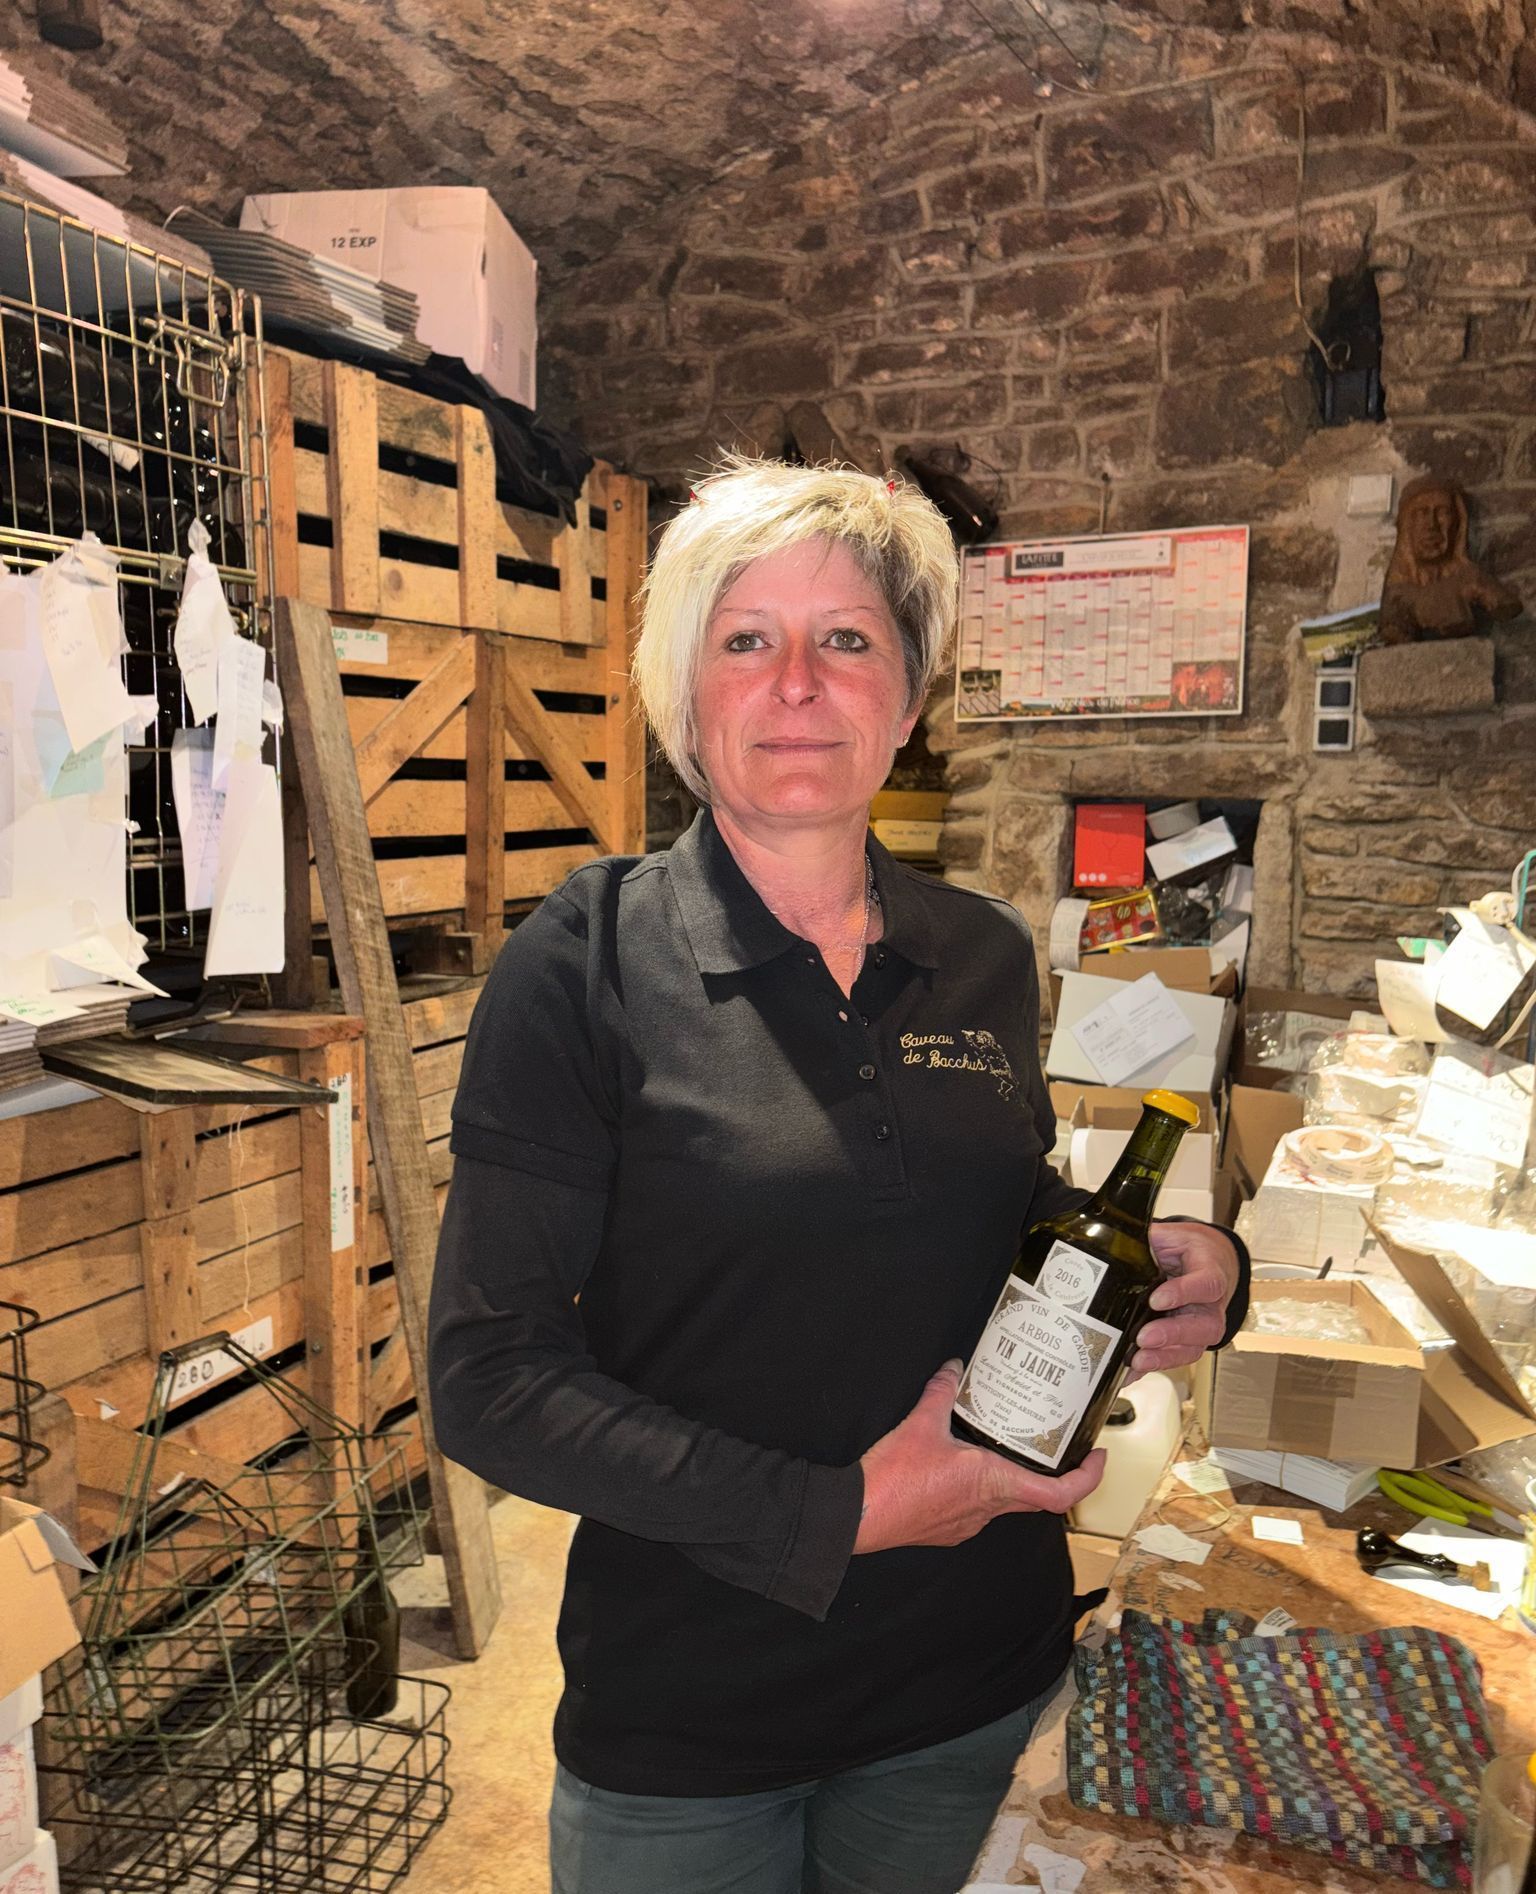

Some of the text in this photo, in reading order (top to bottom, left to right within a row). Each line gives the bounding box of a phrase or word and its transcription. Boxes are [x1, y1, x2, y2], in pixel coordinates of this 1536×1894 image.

[331, 236, 377, 248] 12 EXP
[900, 1033, 955, 1048] Caveau
[903, 1049, 988, 1071] de Bacchus
[1054, 1267, 1081, 1289] 2016
[993, 1303, 1089, 1372] GRAND VIN DE GARDE
[1017, 1319, 1063, 1351] ARBOIS
[993, 1335, 1067, 1387] VIN JAUNE
[178, 1359, 214, 1388] 280
[994, 1379, 1032, 1402] VIGNERONS
[973, 1394, 986, 1417] CAVEAU
[989, 1409, 1008, 1422] FRANCE
